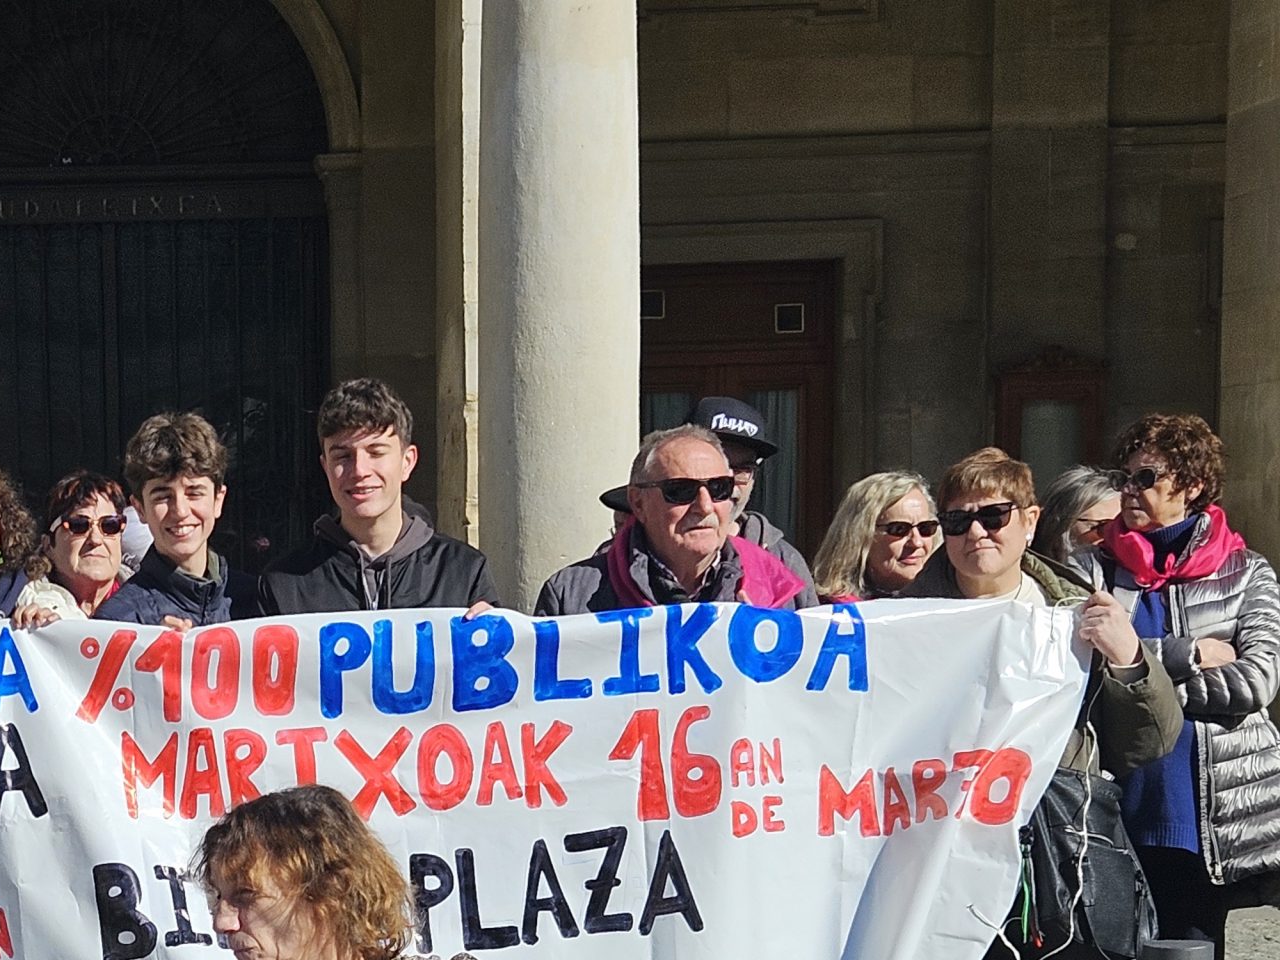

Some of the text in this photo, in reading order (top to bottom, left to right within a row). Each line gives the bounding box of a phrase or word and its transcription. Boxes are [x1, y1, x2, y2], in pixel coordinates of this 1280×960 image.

[75, 624, 298, 723] %100
[319, 602, 869, 719] PUBLIKOA
[121, 720, 573, 820] MARTXOAK
[608, 706, 722, 820] 16
[730, 795, 786, 838] DE
[409, 826, 704, 954] PLAZA
